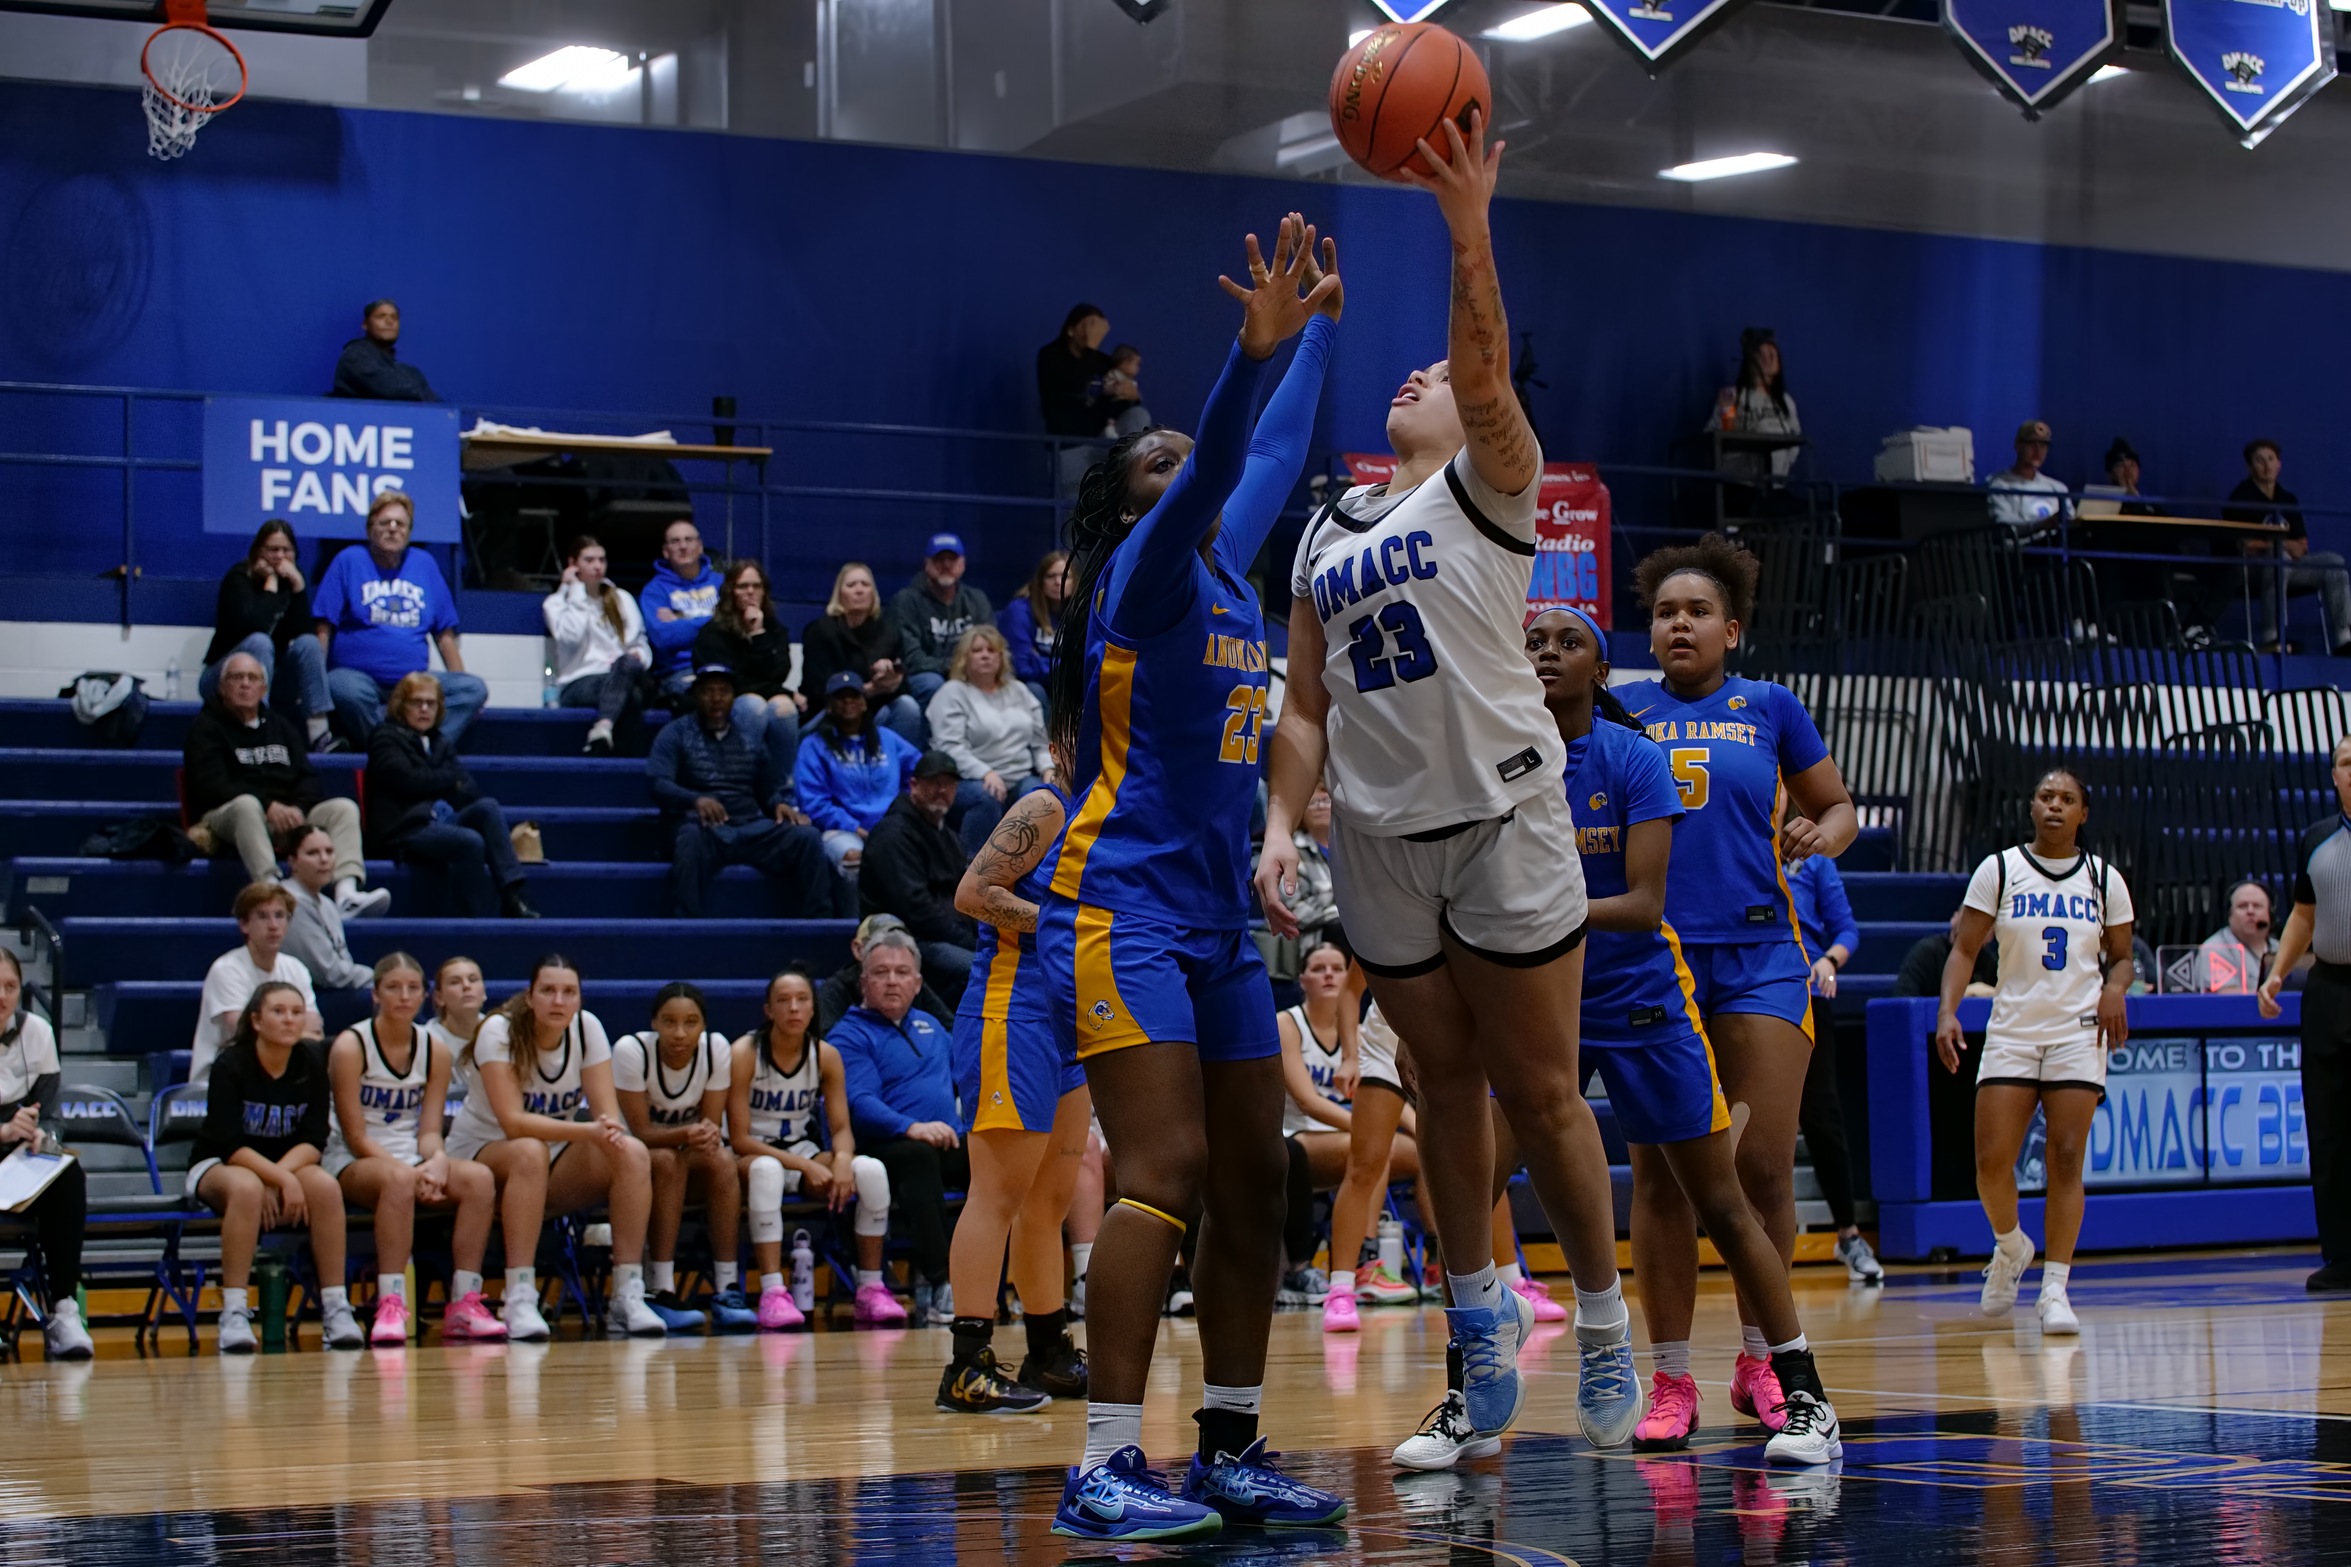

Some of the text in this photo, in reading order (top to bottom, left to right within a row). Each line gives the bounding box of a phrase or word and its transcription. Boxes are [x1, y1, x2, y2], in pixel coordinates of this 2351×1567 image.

[251, 419, 414, 470] HOME
[1313, 530, 1439, 625] DMACC
[1348, 599, 1439, 694] 23
[1218, 684, 1267, 764] 23
[1645, 721, 1757, 747] OKA RAMSEY
[1670, 747, 1710, 810] 5
[1573, 825, 1620, 855] MSEY
[2011, 893, 2097, 923] DMACC
[2042, 926, 2068, 971] 3
[2107, 1042, 2300, 1072] OME TO TH
[2091, 1084, 2306, 1174] DMACC BE
